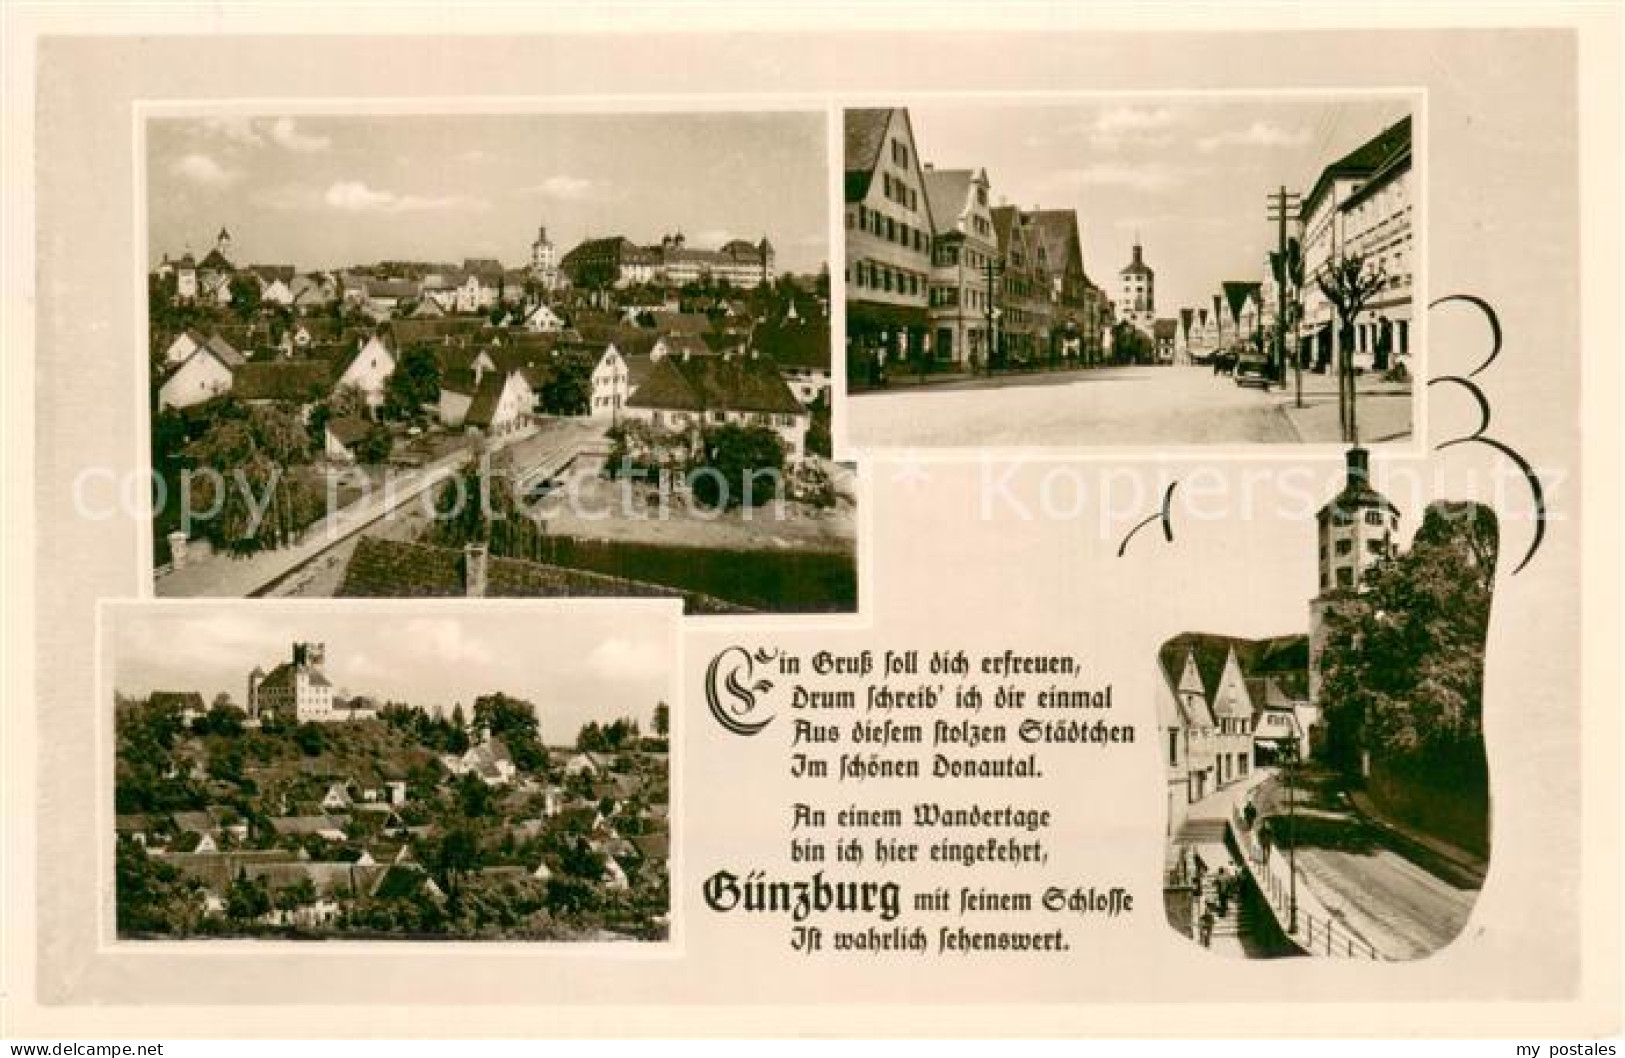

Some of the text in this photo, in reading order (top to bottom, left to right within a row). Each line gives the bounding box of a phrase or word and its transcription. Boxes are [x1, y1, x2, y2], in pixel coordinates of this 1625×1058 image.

[811, 649, 874, 677] Gruß
[930, 649, 969, 674] dich
[791, 684, 855, 709] Drum
[955, 684, 983, 709] ich
[995, 684, 1027, 709] dir
[1037, 684, 1113, 709] einmal
[793, 718, 840, 746] Aus
[1018, 718, 1134, 744] Städtchen
[932, 753, 1043, 779] Donautal.
[793, 802, 1051, 832] An einem Wandertage
[791, 837, 1048, 867] bin ich hier eingekehrt,
[702, 869, 901, 923] Günzburg
[914, 888, 950, 911] mit
[834, 926, 927, 951] wahrlich
